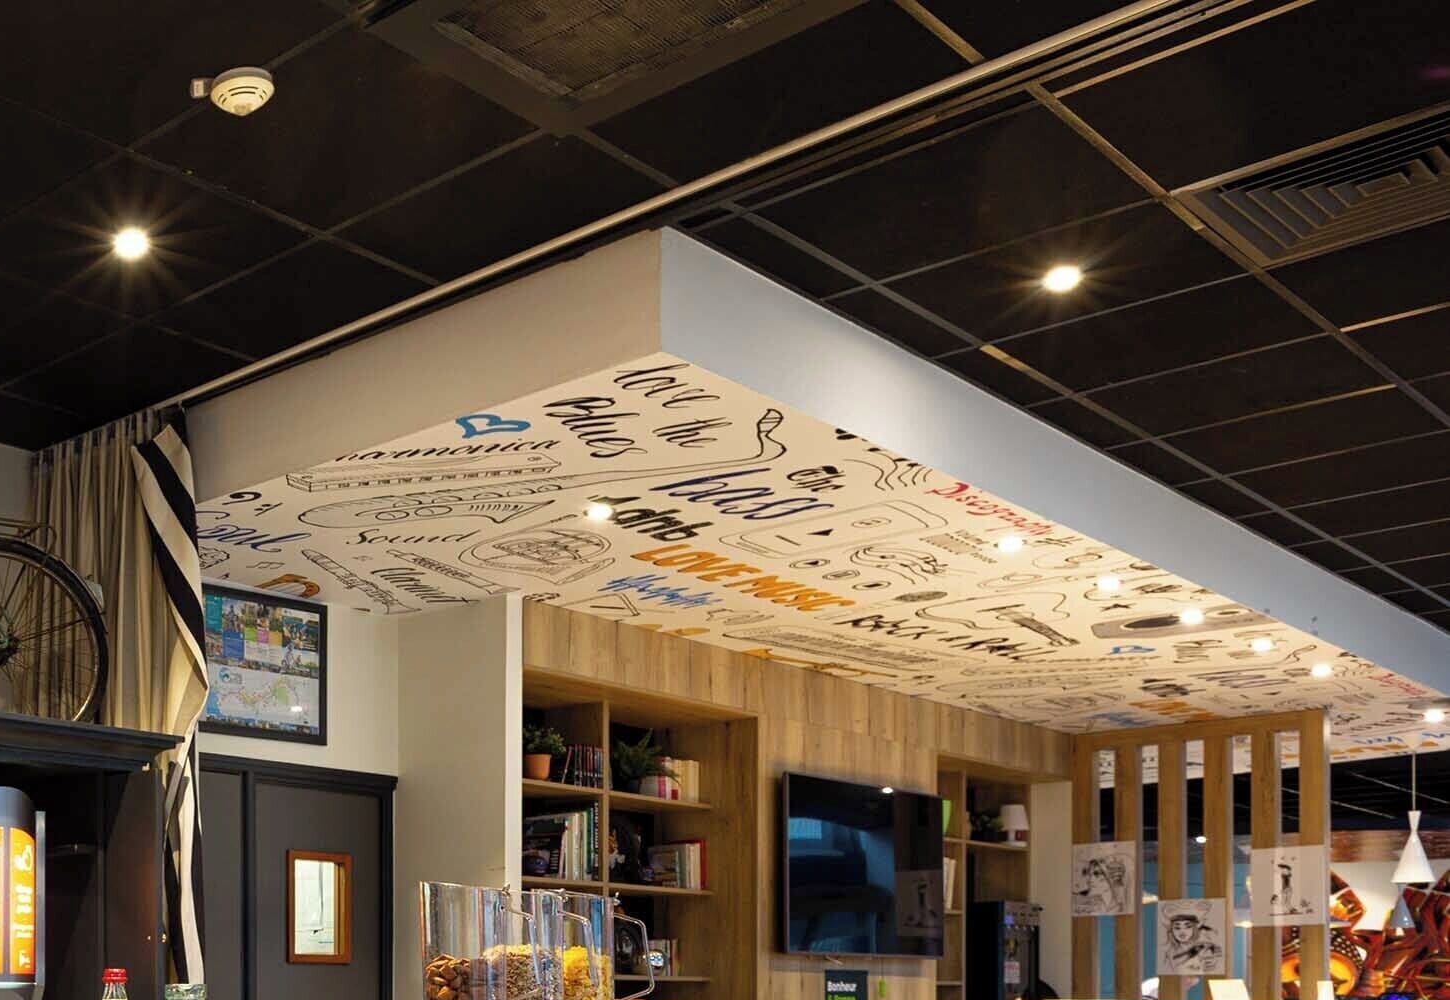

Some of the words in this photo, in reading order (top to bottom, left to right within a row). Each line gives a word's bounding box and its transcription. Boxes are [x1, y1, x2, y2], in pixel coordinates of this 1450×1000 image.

[542, 396, 649, 459] Blues
[346, 528, 482, 546] Sound
[629, 543, 764, 583] LOVE
[722, 575, 857, 612] MUSIC
